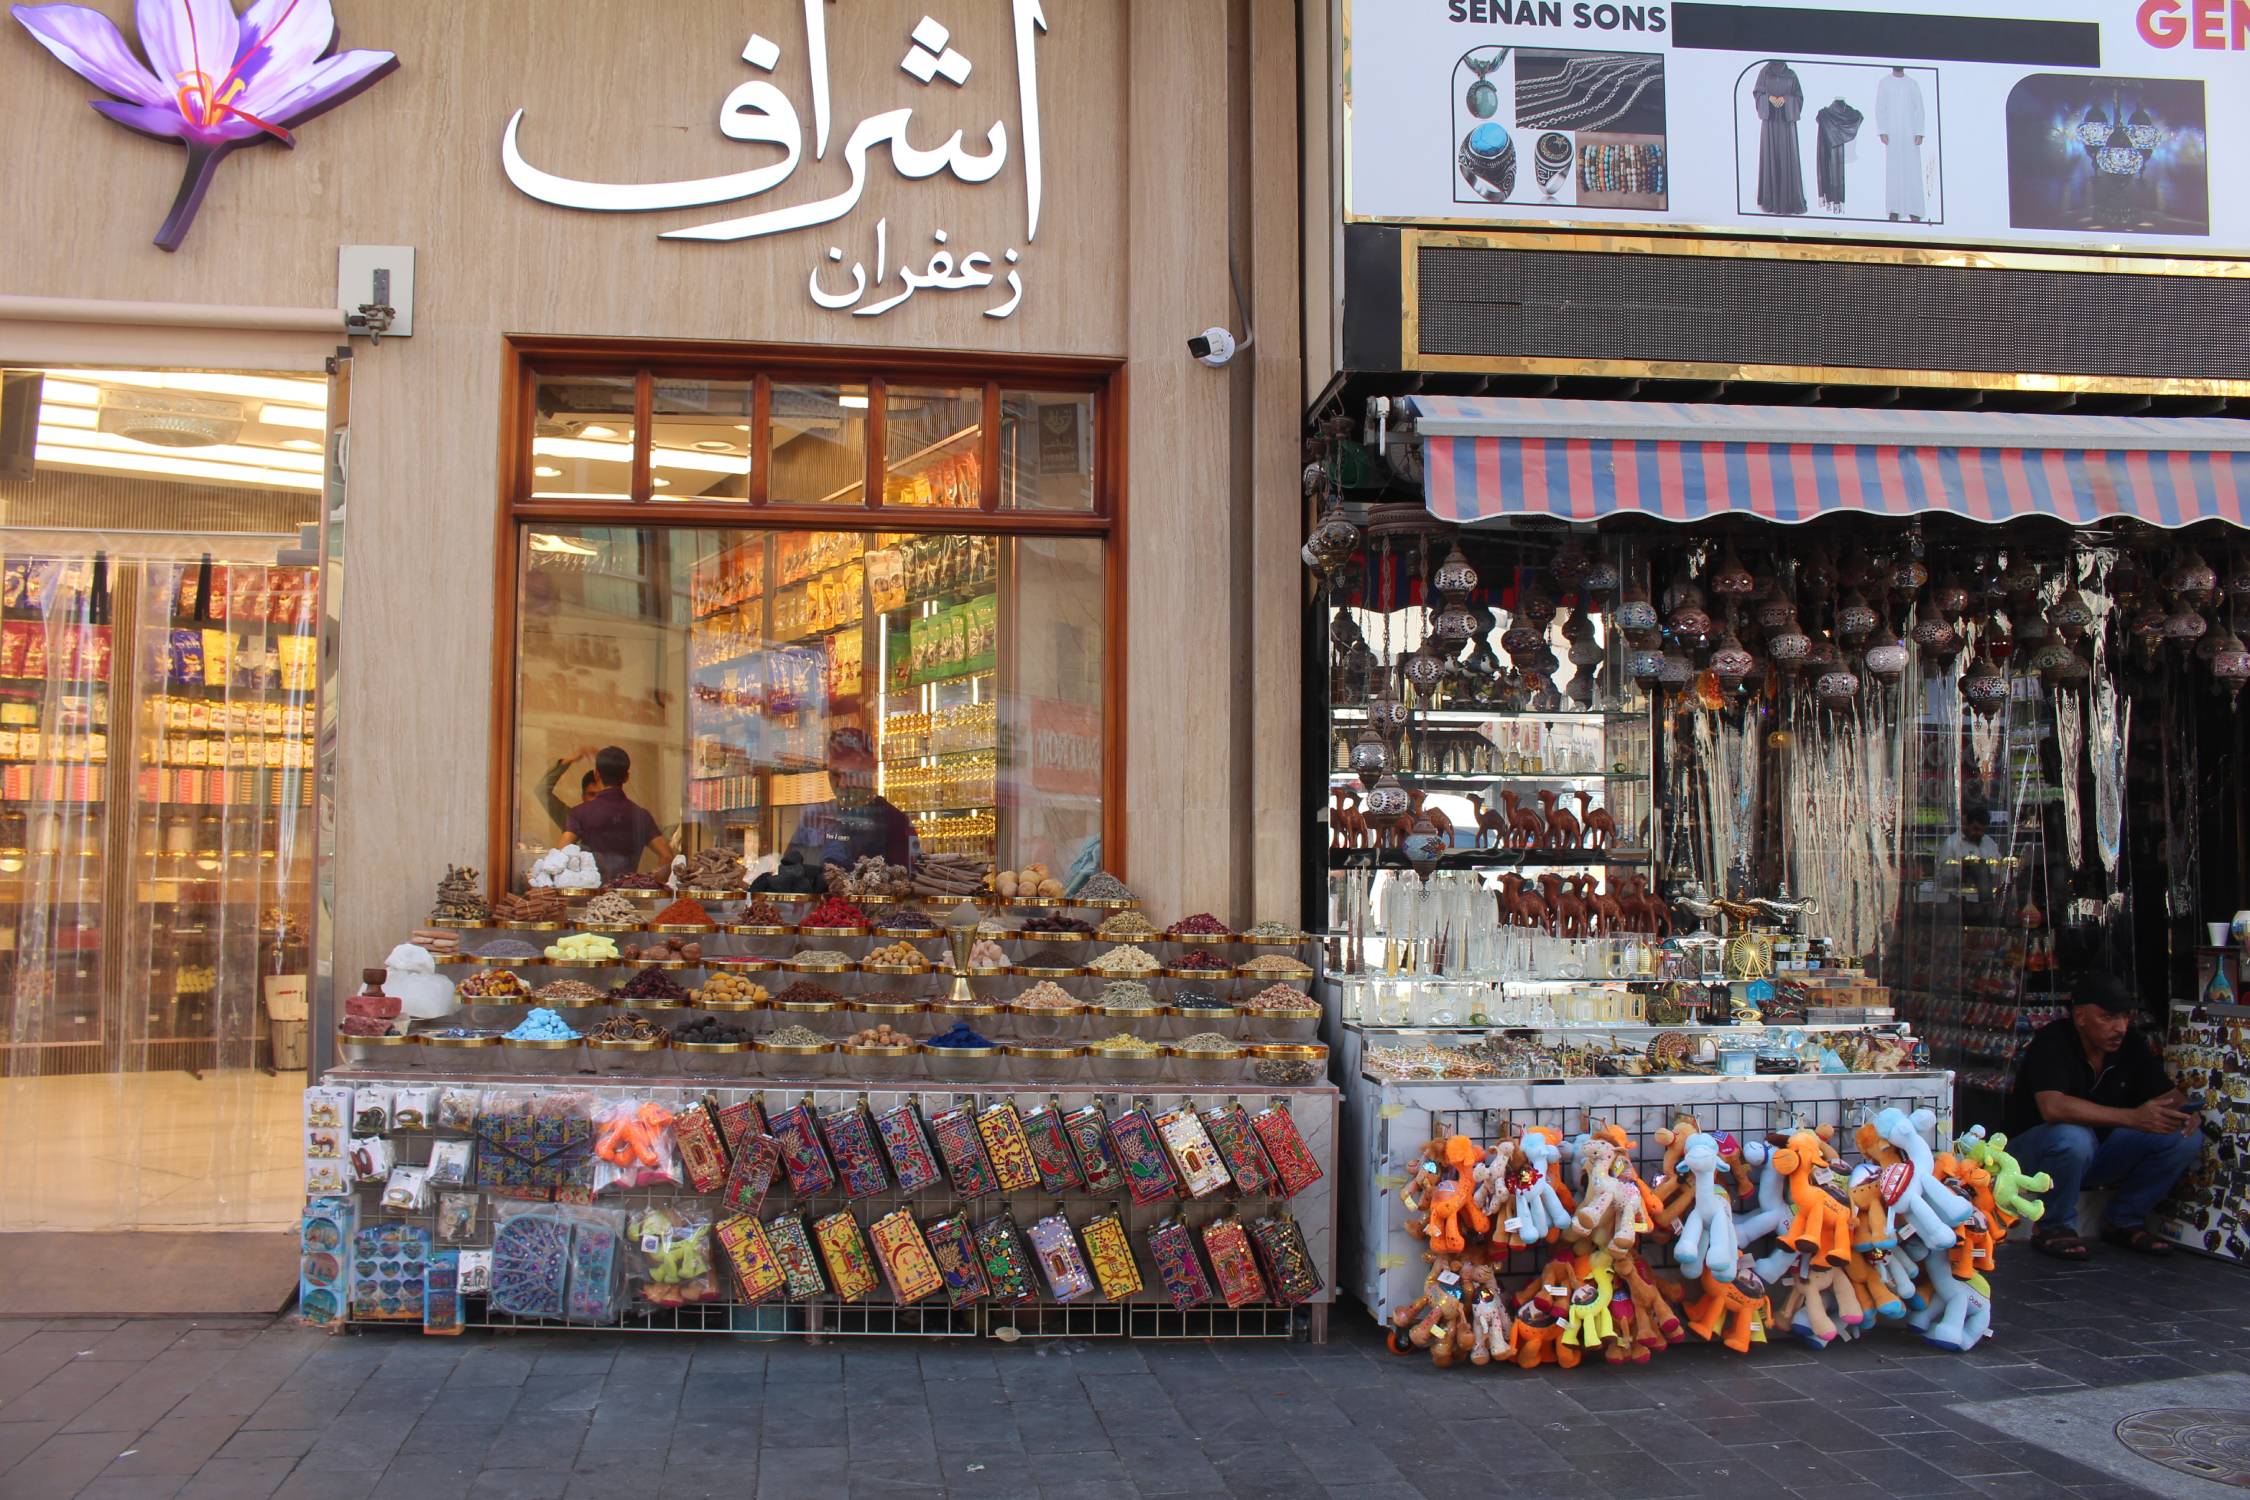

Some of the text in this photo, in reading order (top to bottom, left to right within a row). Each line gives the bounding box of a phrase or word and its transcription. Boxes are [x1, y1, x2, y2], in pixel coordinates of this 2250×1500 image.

[1448, 0, 1667, 33] SENAN SONS
[808, 217, 1023, 318] زعفران
[753, 1238, 769, 1263] DUBAI
[877, 1230, 892, 1254] DUBAI
